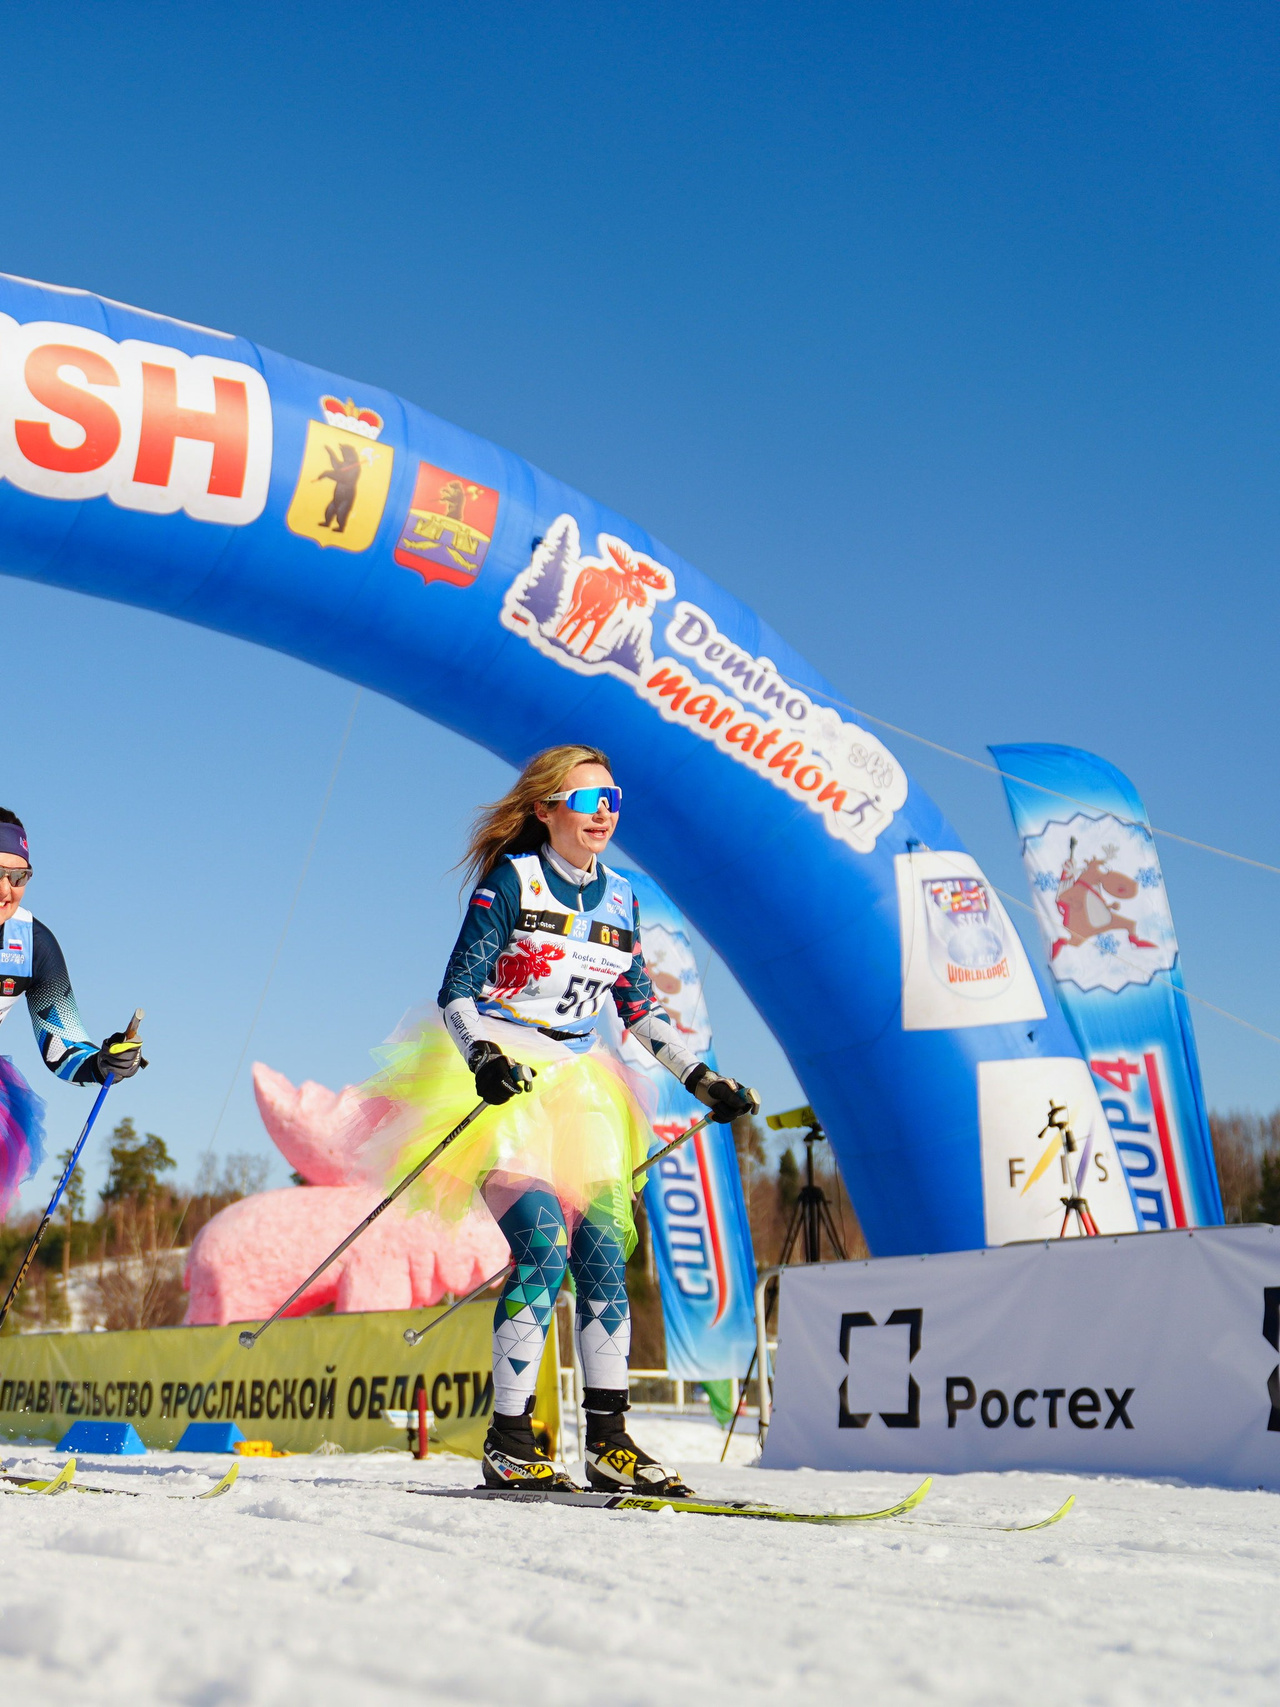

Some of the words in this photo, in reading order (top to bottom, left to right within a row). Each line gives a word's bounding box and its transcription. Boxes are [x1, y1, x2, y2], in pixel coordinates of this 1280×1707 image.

[675, 611, 807, 720] Demino
[646, 667, 848, 812] marathon
[572, 928, 585, 939] KM
[575, 919, 588, 930] 25
[572, 951, 597, 964] Rostec
[588, 964, 618, 977] marathon
[946, 956, 1011, 984] WORLDLOPPET
[450, 1011, 468, 1035] СПОРТ
[0, 1379, 153, 1418] ПРАВИТЕЛЬСТВО
[159, 1365, 336, 1420] ЯРОСЛАВСКОЙ
[347, 1370, 494, 1420] ОБЛАСТИ
[945, 1375, 1135, 1430] Ростех
[622, 1498, 654, 1509] RCS
